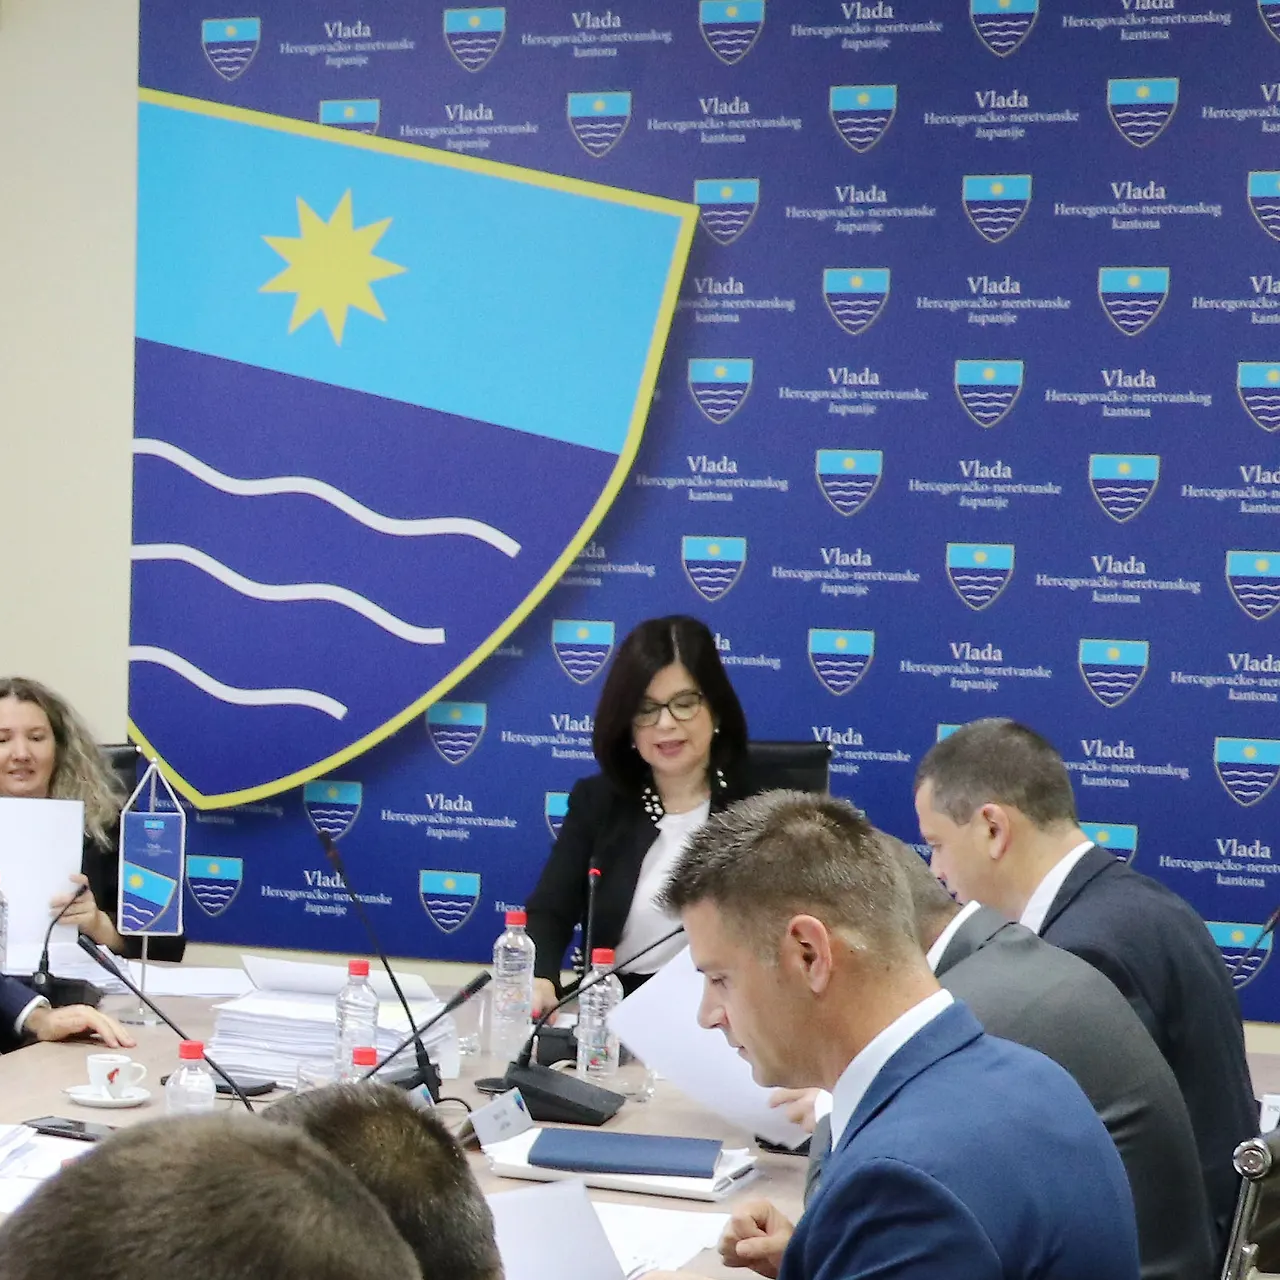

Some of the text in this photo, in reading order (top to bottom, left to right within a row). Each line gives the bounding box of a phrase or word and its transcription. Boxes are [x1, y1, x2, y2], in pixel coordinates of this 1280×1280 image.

[841, 2, 894, 19] Vlada
[572, 11, 621, 28] Vlada
[1062, 12, 1231, 29] Hercegovačko-neretvanskog
[324, 21, 371, 38] Vlada
[1121, 29, 1169, 40] kantona
[699, 98, 750, 114] Vlada
[975, 90, 1029, 108] Vlada
[444, 104, 493, 121] Vlada
[700, 132, 746, 144] kantona
[975, 126, 1025, 141] županije
[834, 185, 887, 203] Vlada
[1111, 181, 1166, 200] Vlada
[835, 219, 883, 235] županije
[1112, 218, 1160, 230] kantona
[694, 277, 744, 294] Vlada
[967, 276, 1021, 294] Vlada
[1250, 276, 1280, 293] Vla
[968, 311, 1017, 326] županije
[828, 367, 879, 386] Vlada
[1101, 370, 1156, 388] Vlada
[828, 402, 876, 417] županije
[1103, 406, 1151, 417] kantona
[687, 456, 738, 473] Vlada
[959, 460, 1012, 479] Vlada
[689, 490, 733, 501] kantona
[959, 495, 1008, 511] županije
[820, 548, 872, 566] Vlada
[1092, 556, 1146, 574] Vlada
[821, 582, 868, 597] županije
[1093, 591, 1141, 603] kantona
[950, 642, 1003, 661] Vlada
[950, 677, 998, 692] županije
[1229, 689, 1277, 701] kantona
[812, 726, 863, 745] Vlada
[1081, 740, 1135, 759] Vlada
[1082, 775, 1129, 787] kantona
[425, 794, 472, 812] Vlada
[1217, 839, 1271, 858] Vlada
[1217, 876, 1265, 887] kantona
